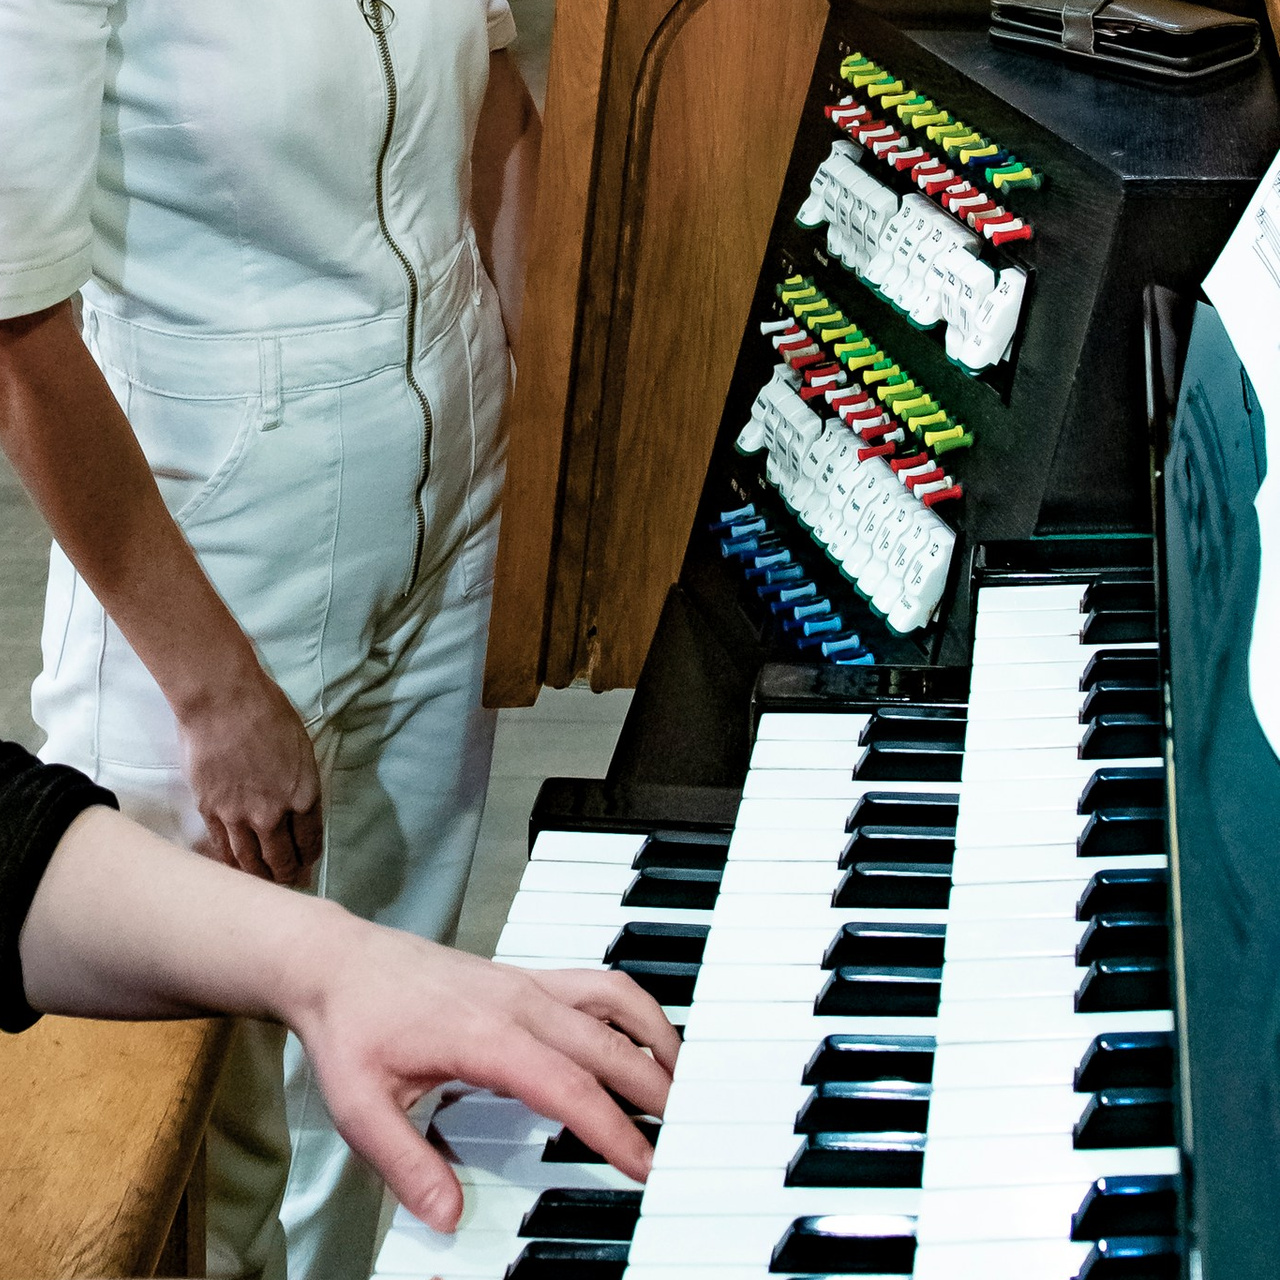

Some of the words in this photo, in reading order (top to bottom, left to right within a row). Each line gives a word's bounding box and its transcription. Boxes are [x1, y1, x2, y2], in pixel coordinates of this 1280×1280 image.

[931, 228, 943, 243] 20
[999, 281, 1011, 297] 24
[896, 508, 906, 523] 10
[910, 525, 922, 540] 11
[927, 542, 940, 557] 12
